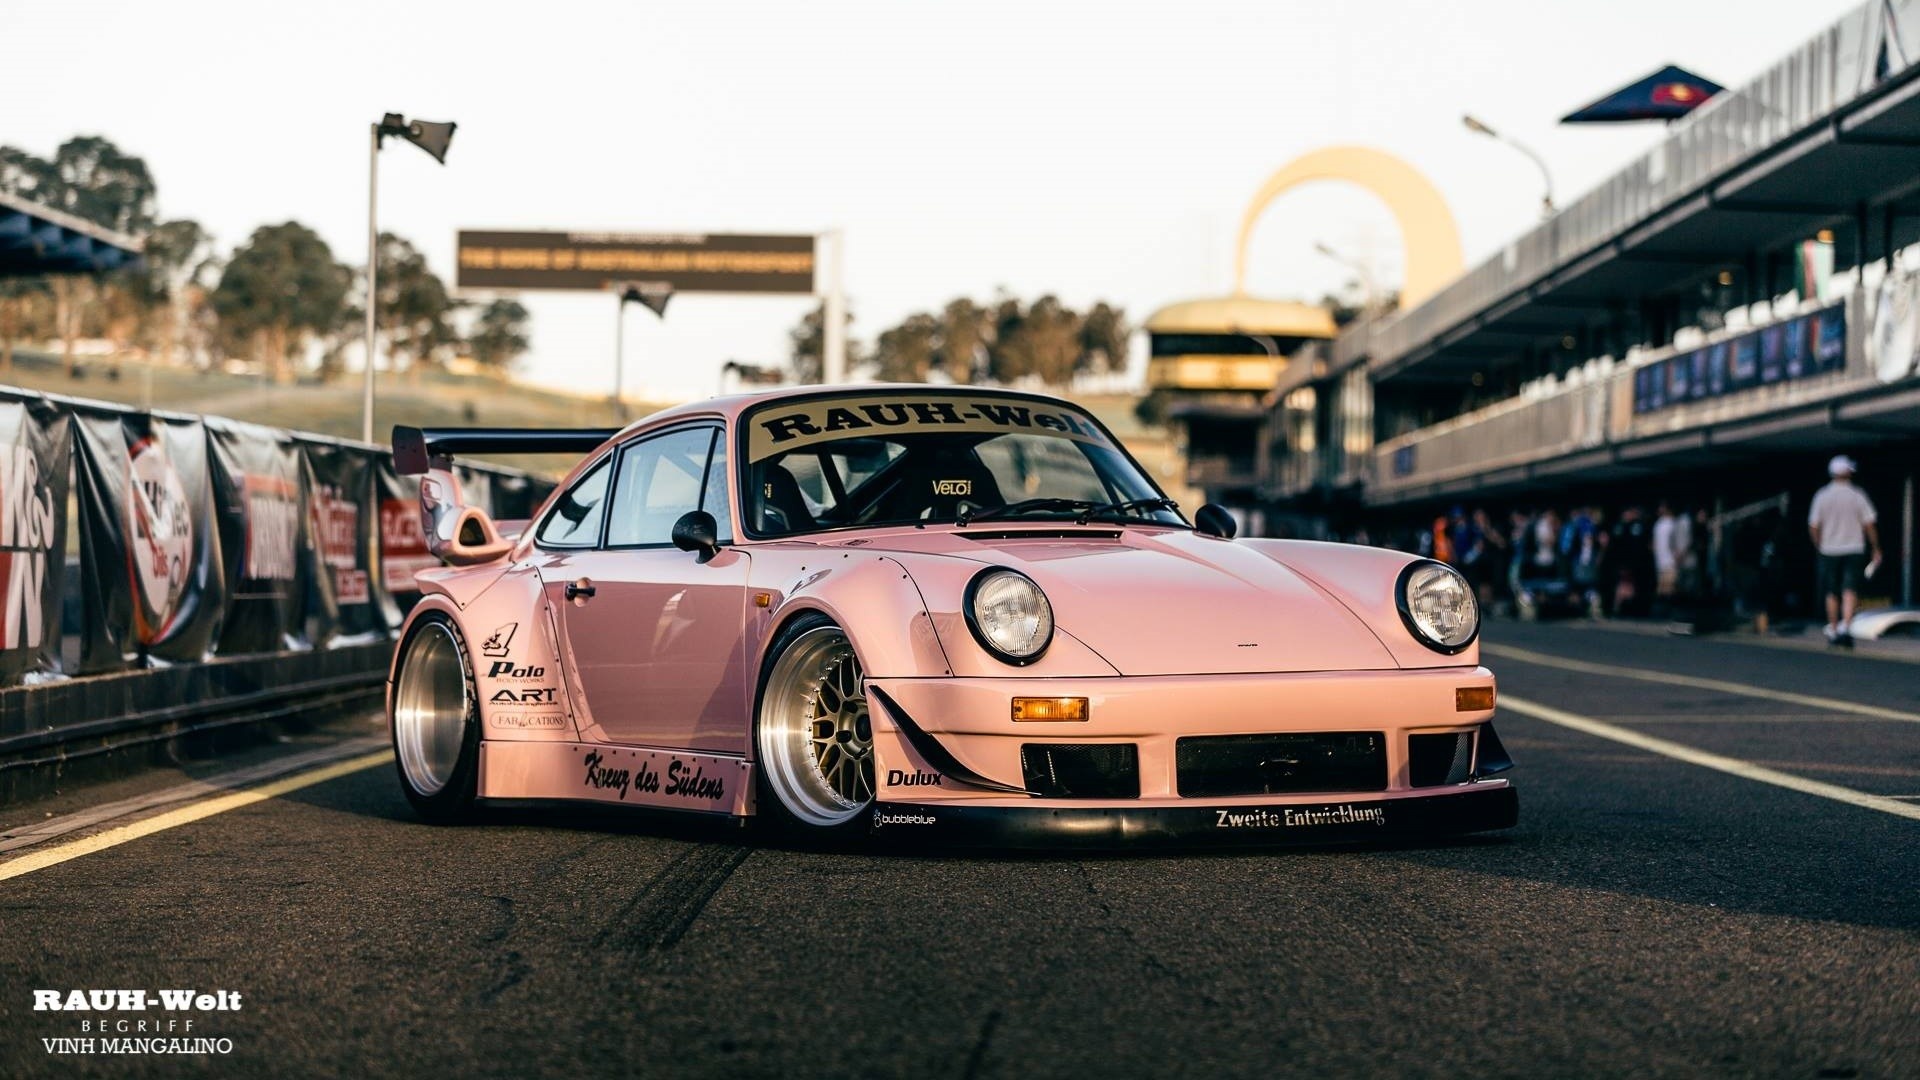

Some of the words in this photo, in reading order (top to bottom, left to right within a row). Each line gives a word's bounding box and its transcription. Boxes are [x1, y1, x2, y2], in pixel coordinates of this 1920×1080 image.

[761, 403, 1100, 444] RAUH-Welt
[488, 661, 545, 678] Polo
[490, 687, 557, 702] ART
[584, 752, 630, 800] Kreuz
[634, 761, 659, 793] des
[665, 760, 724, 800] Südens
[887, 769, 942, 786] Dulux
[882, 814, 936, 825] bubbleblue
[1216, 809, 1279, 828] Zweite
[1284, 805, 1385, 827] Entwicklung
